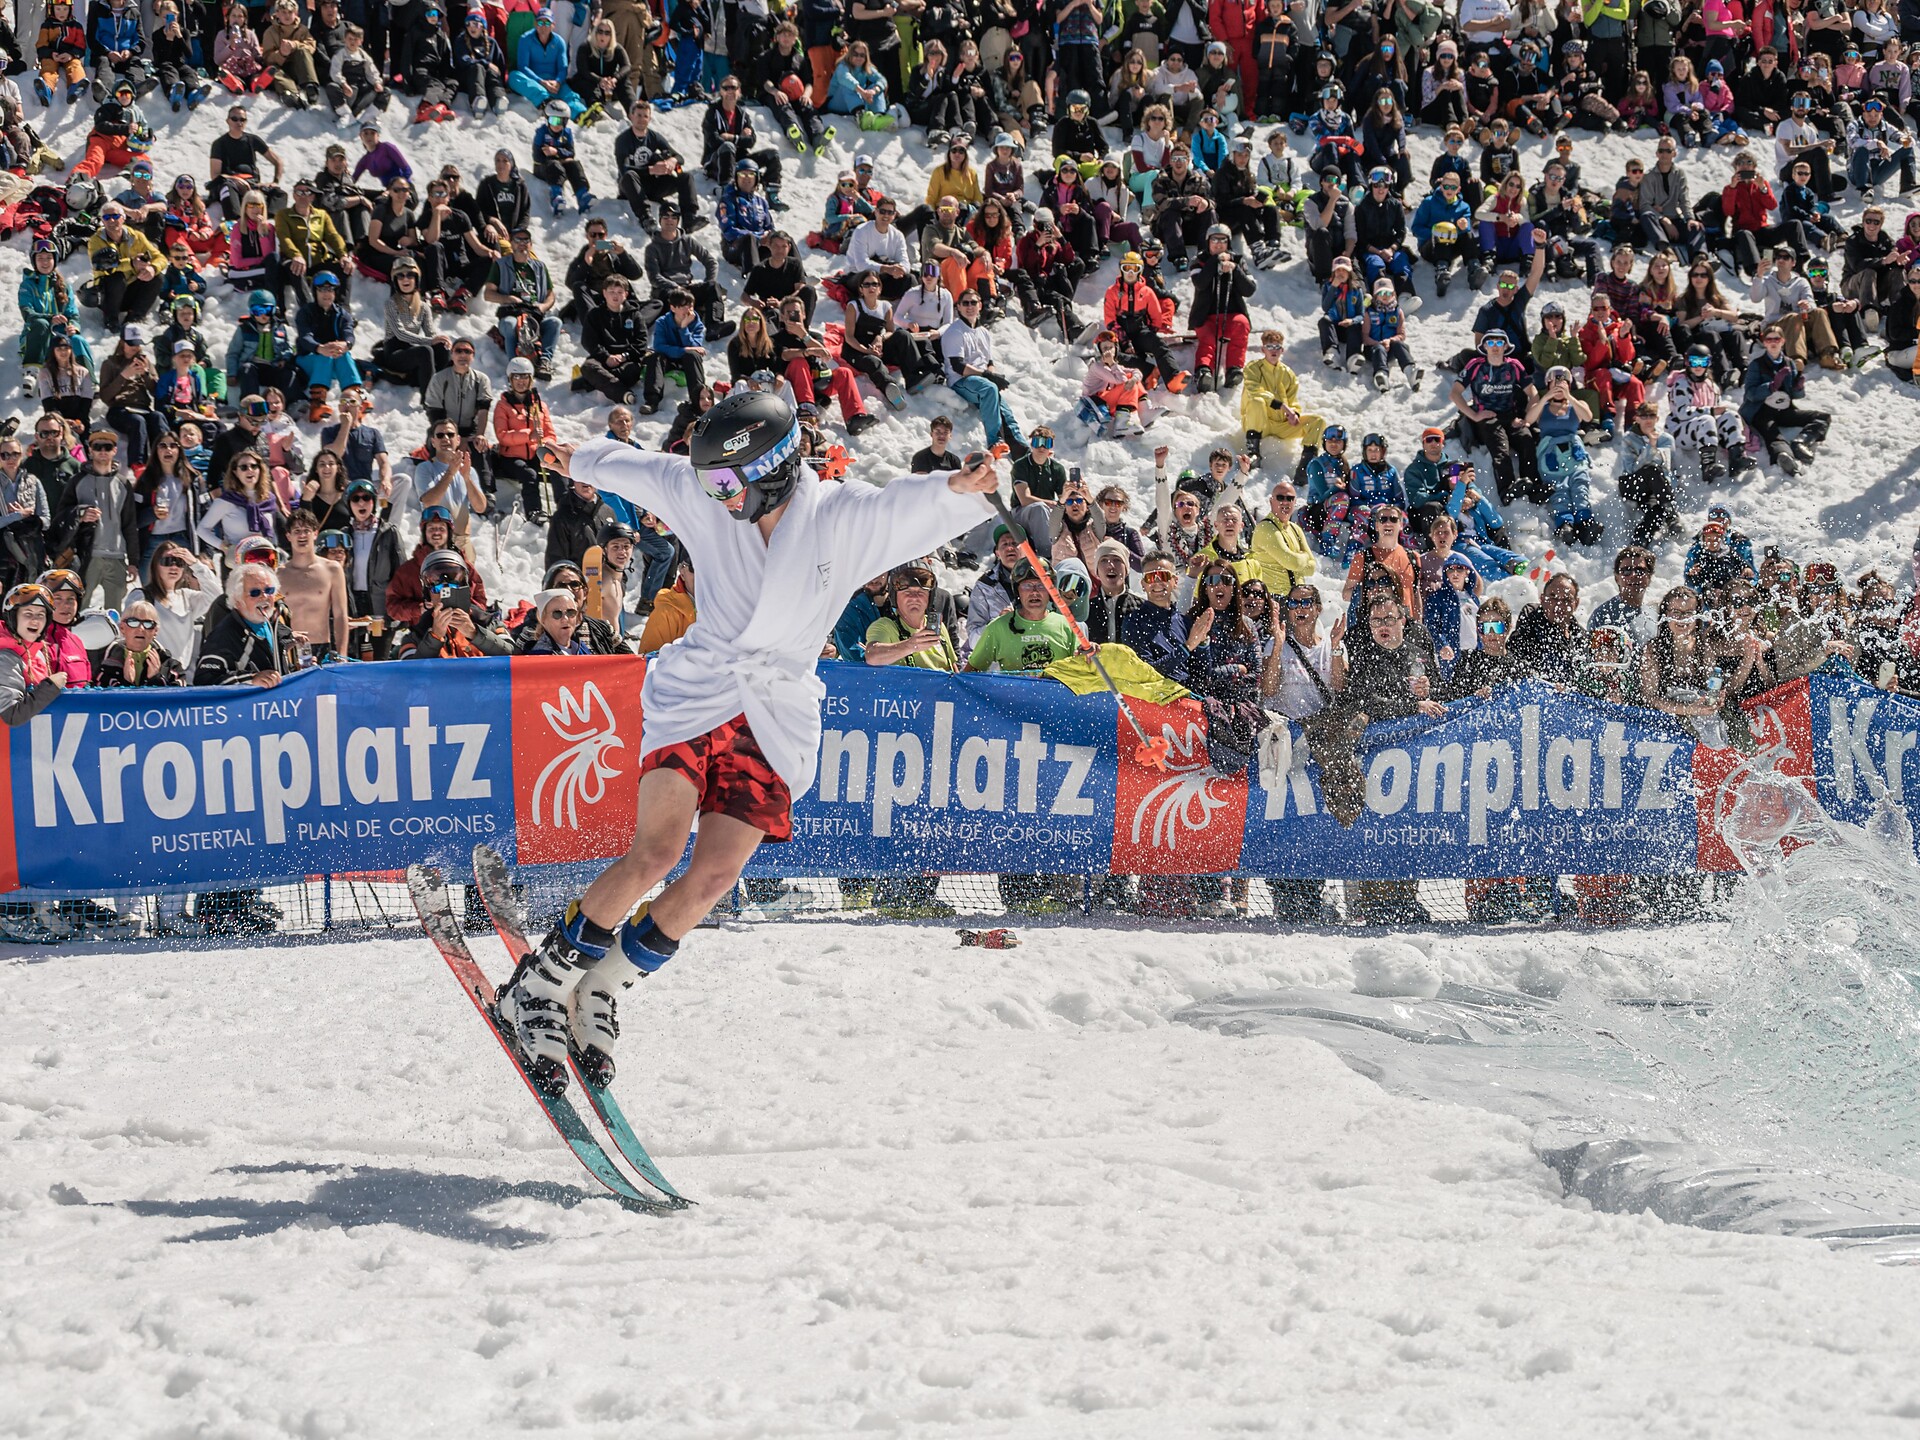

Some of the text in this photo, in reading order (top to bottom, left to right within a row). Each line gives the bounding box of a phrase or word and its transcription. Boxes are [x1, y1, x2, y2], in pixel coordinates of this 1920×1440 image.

[731, 433, 750, 447] FWT
[100, 698, 302, 732] DOLOMITES ITALY
[873, 699, 922, 719] ITALY
[30, 694, 492, 845] Kronplatz
[819, 700, 1099, 838] nplatz
[1258, 704, 1680, 846] Konplatz
[151, 814, 496, 853] PUSTERTAL PLAN DE CORONES
[791, 817, 1094, 846] STERTAL PLAN DE CORONES
[1363, 827, 1459, 846] PUSTERTAL
[1499, 824, 1545, 845] PLAN
[1552, 825, 1576, 843] DE
